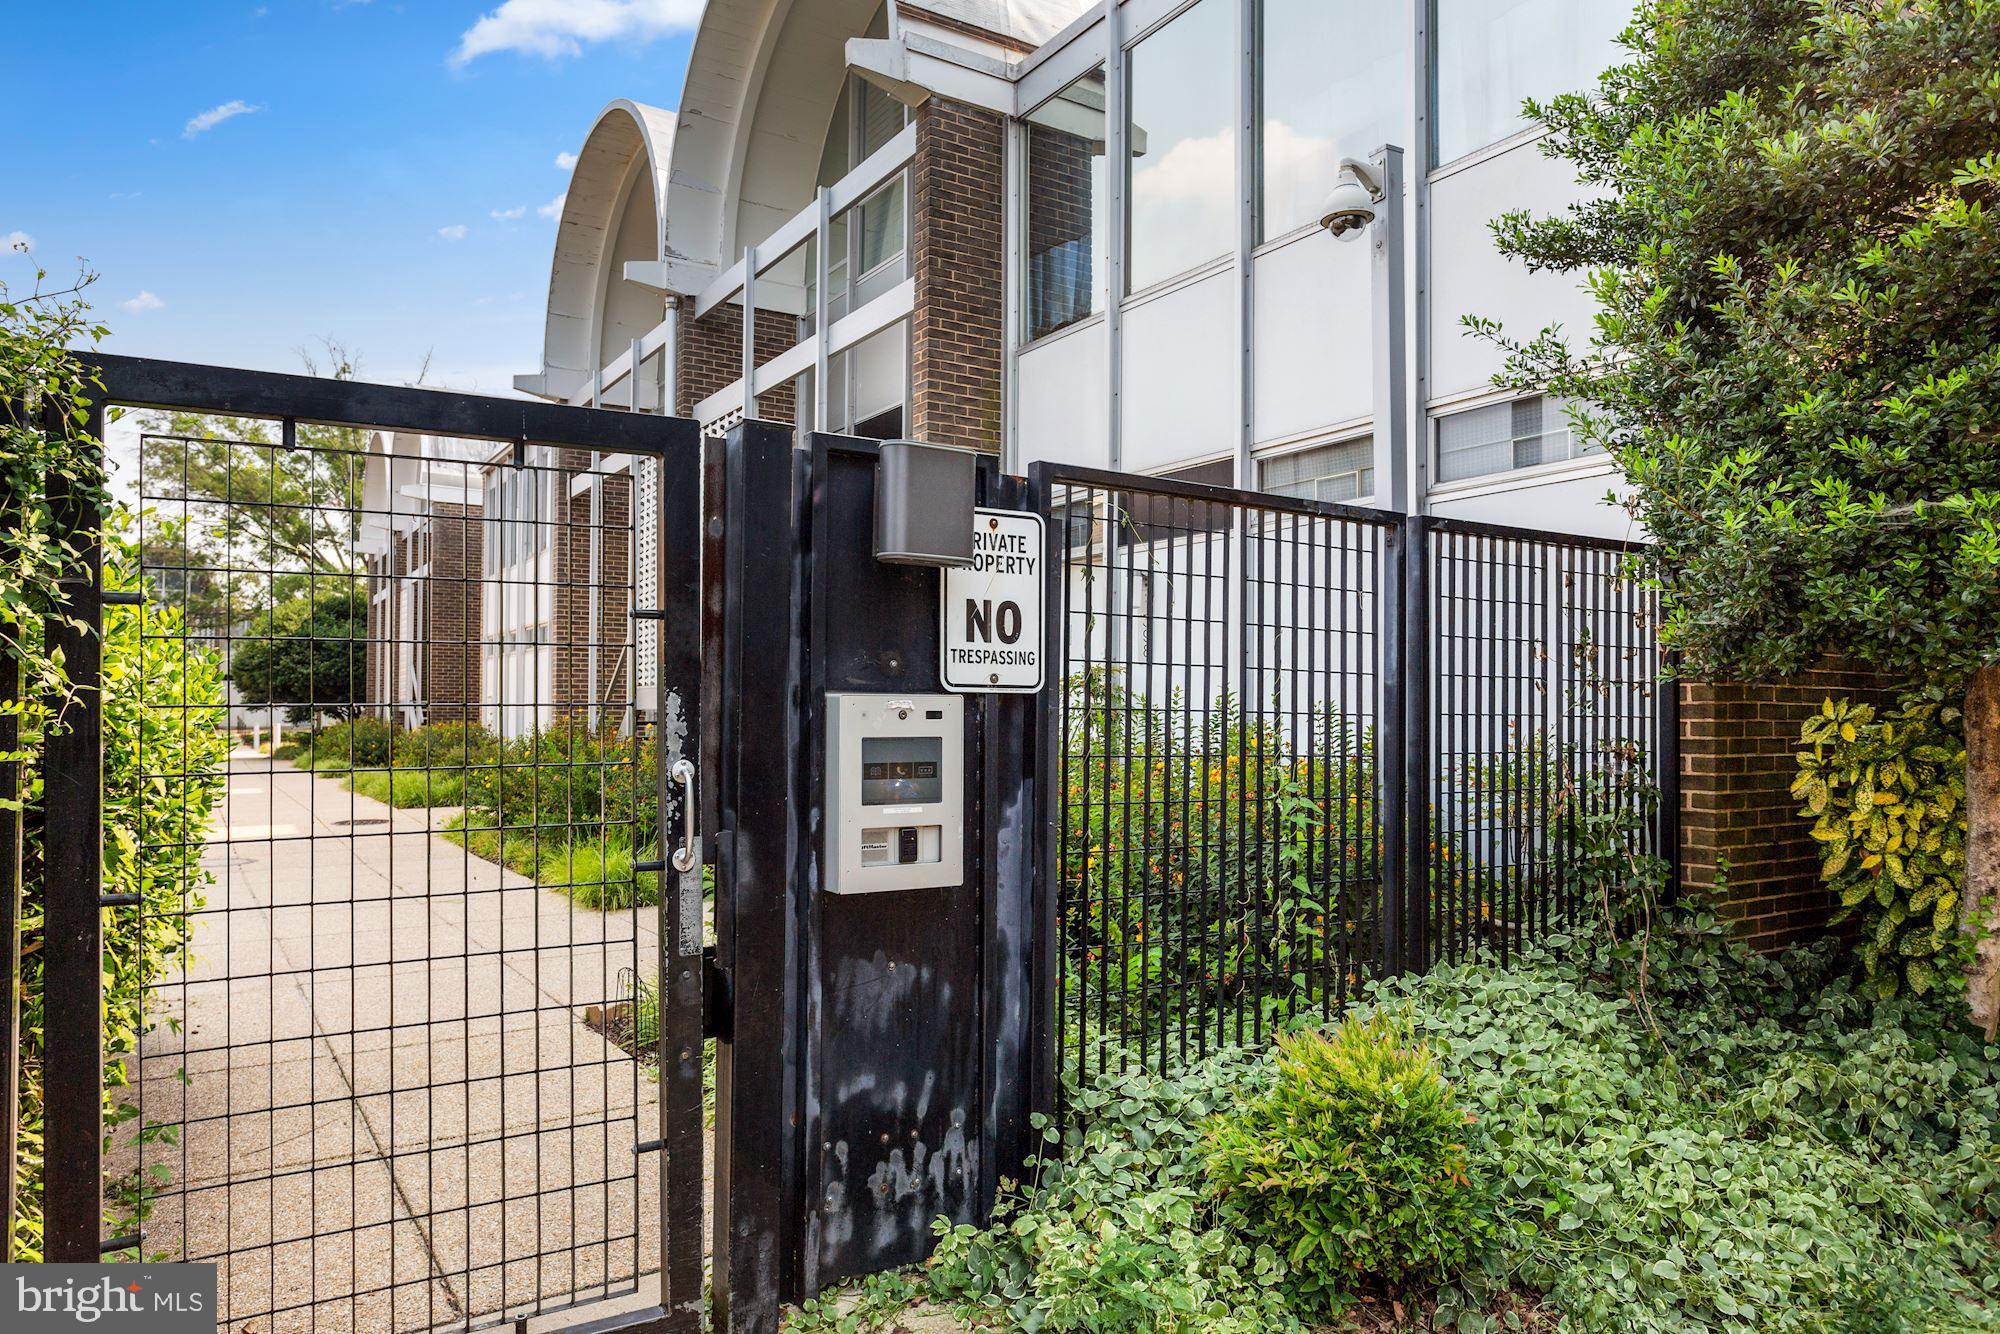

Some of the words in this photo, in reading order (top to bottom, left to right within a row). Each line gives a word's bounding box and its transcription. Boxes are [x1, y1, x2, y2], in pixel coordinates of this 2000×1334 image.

[973, 532, 1027, 554] RIVATE
[952, 553, 1036, 576] OPERTY
[966, 599, 1022, 645] NO
[951, 649, 1036, 666] TRESPASSING
